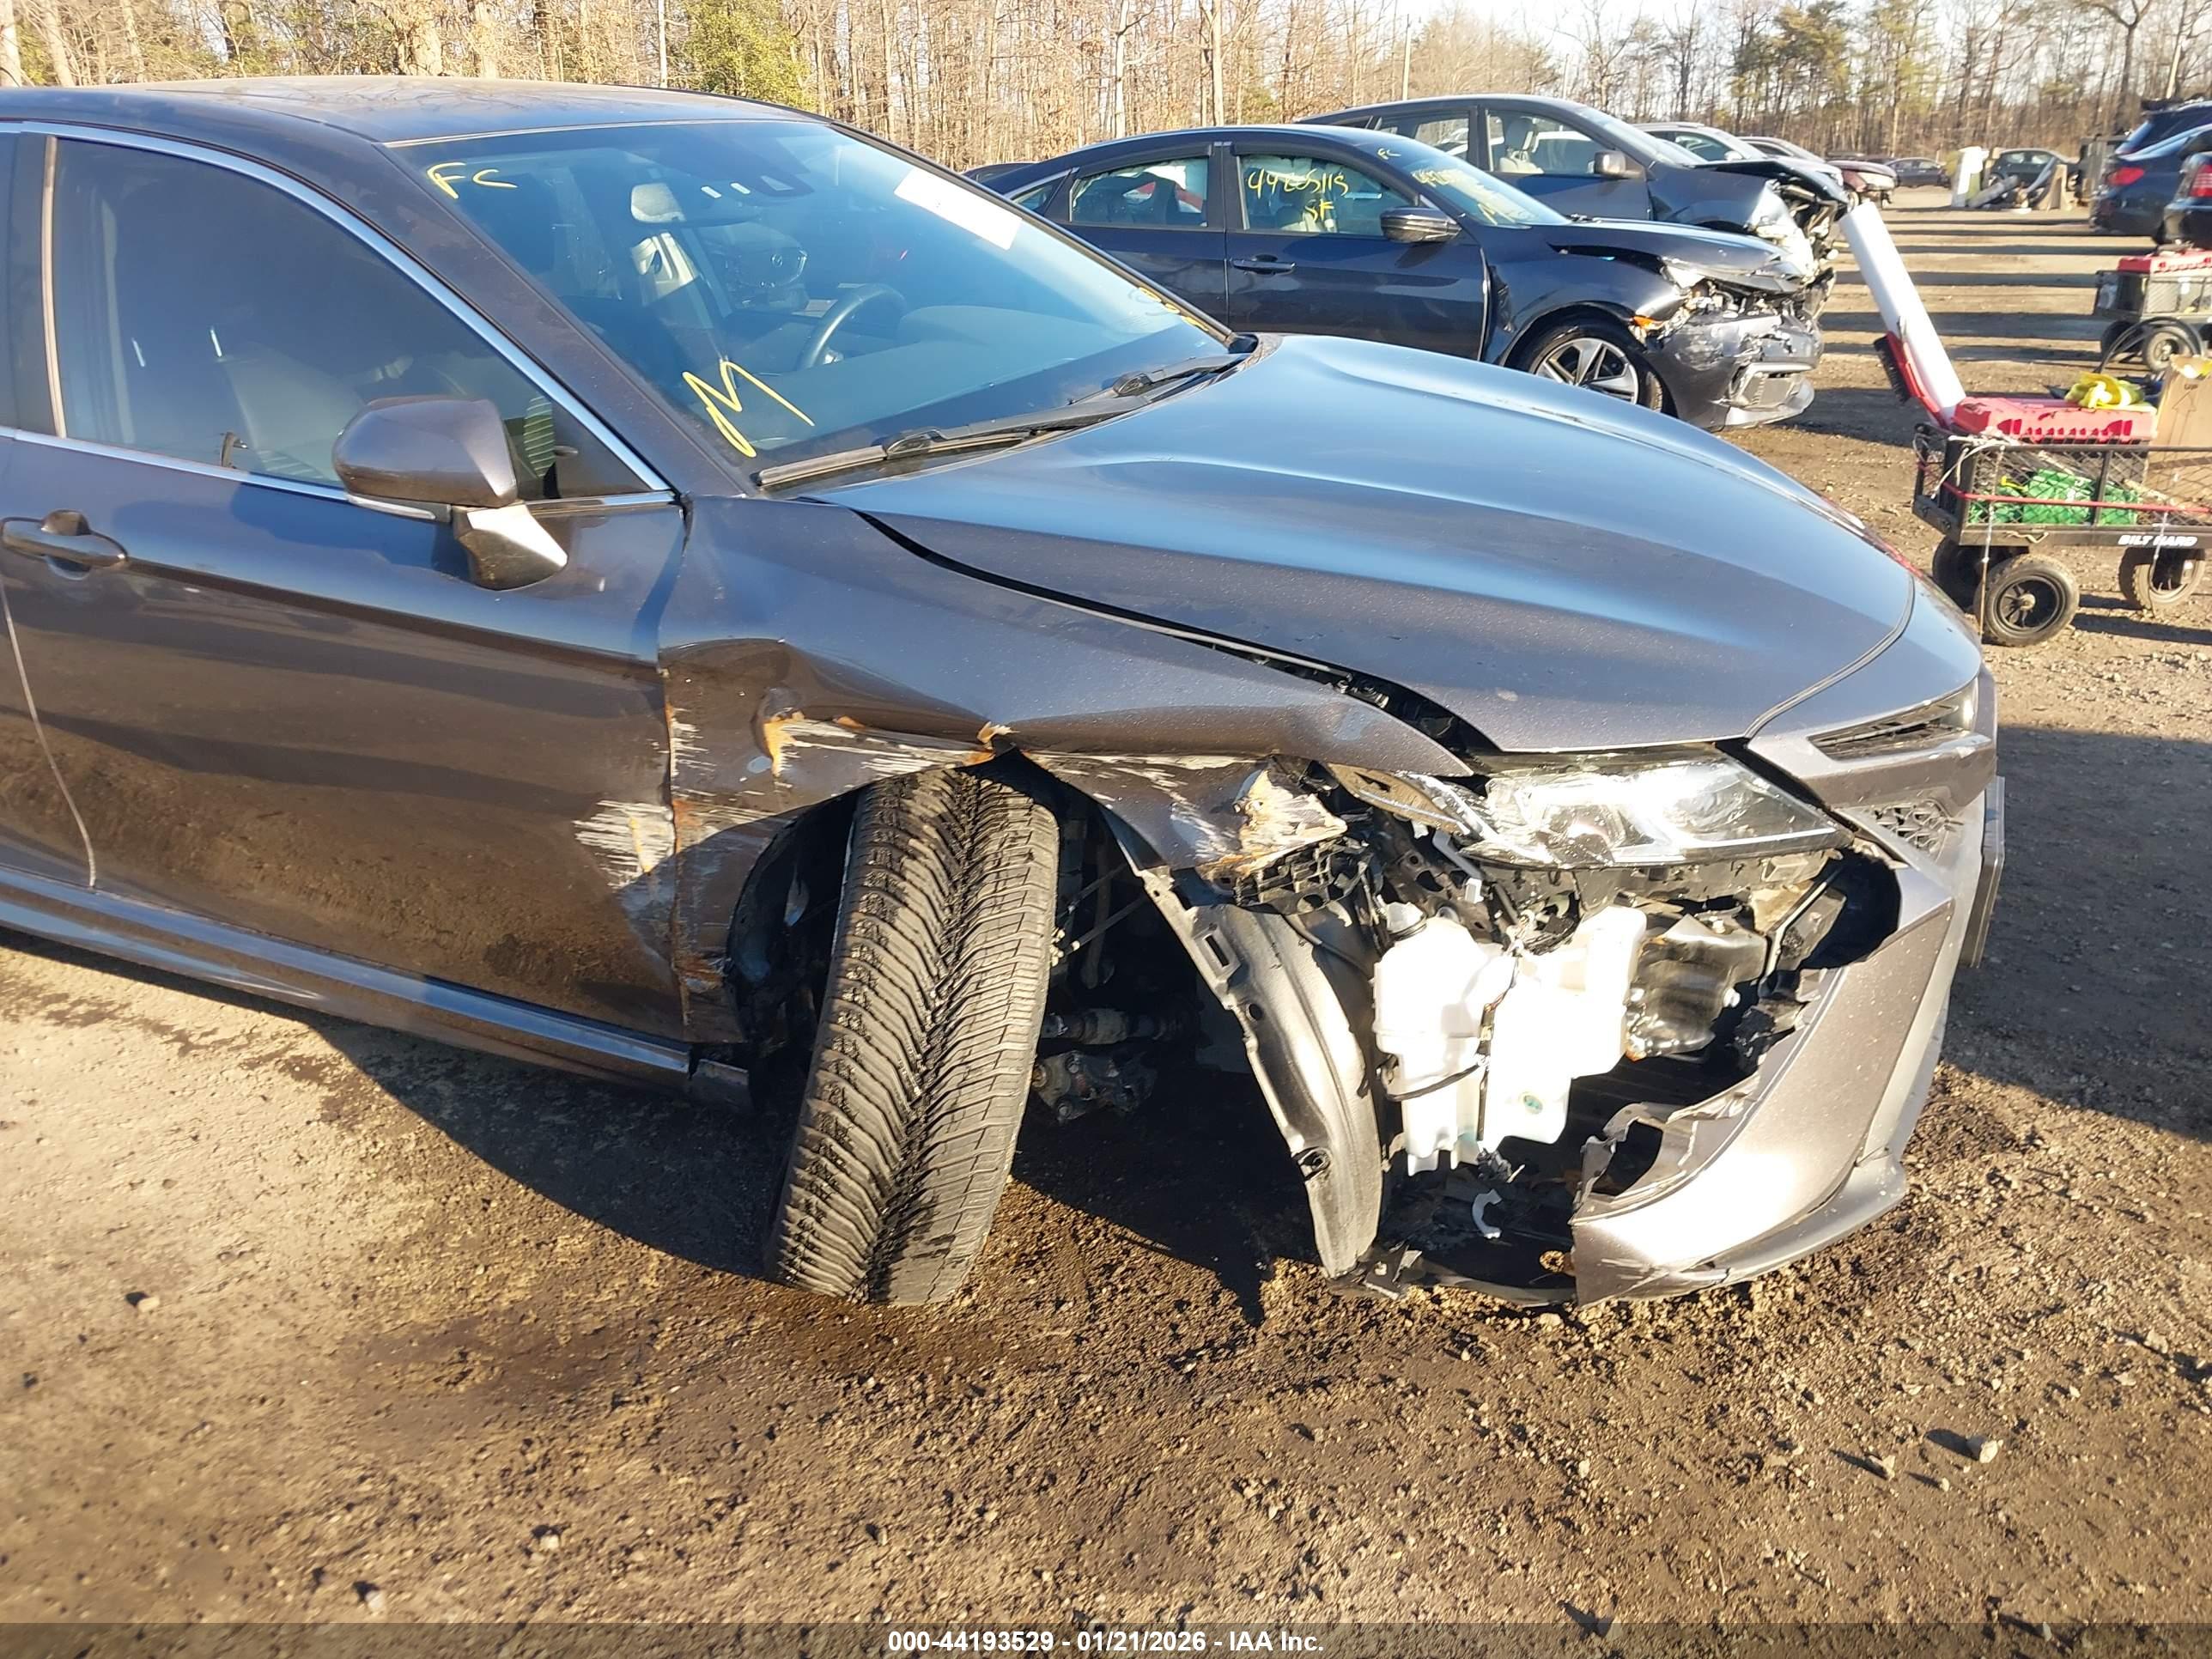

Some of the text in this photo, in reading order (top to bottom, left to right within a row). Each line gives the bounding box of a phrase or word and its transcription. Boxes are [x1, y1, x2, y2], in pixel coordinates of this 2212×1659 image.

[426, 161, 519, 199] FC
[682, 361, 816, 458] M
[2118, 534, 2198, 547] BILT HARD
